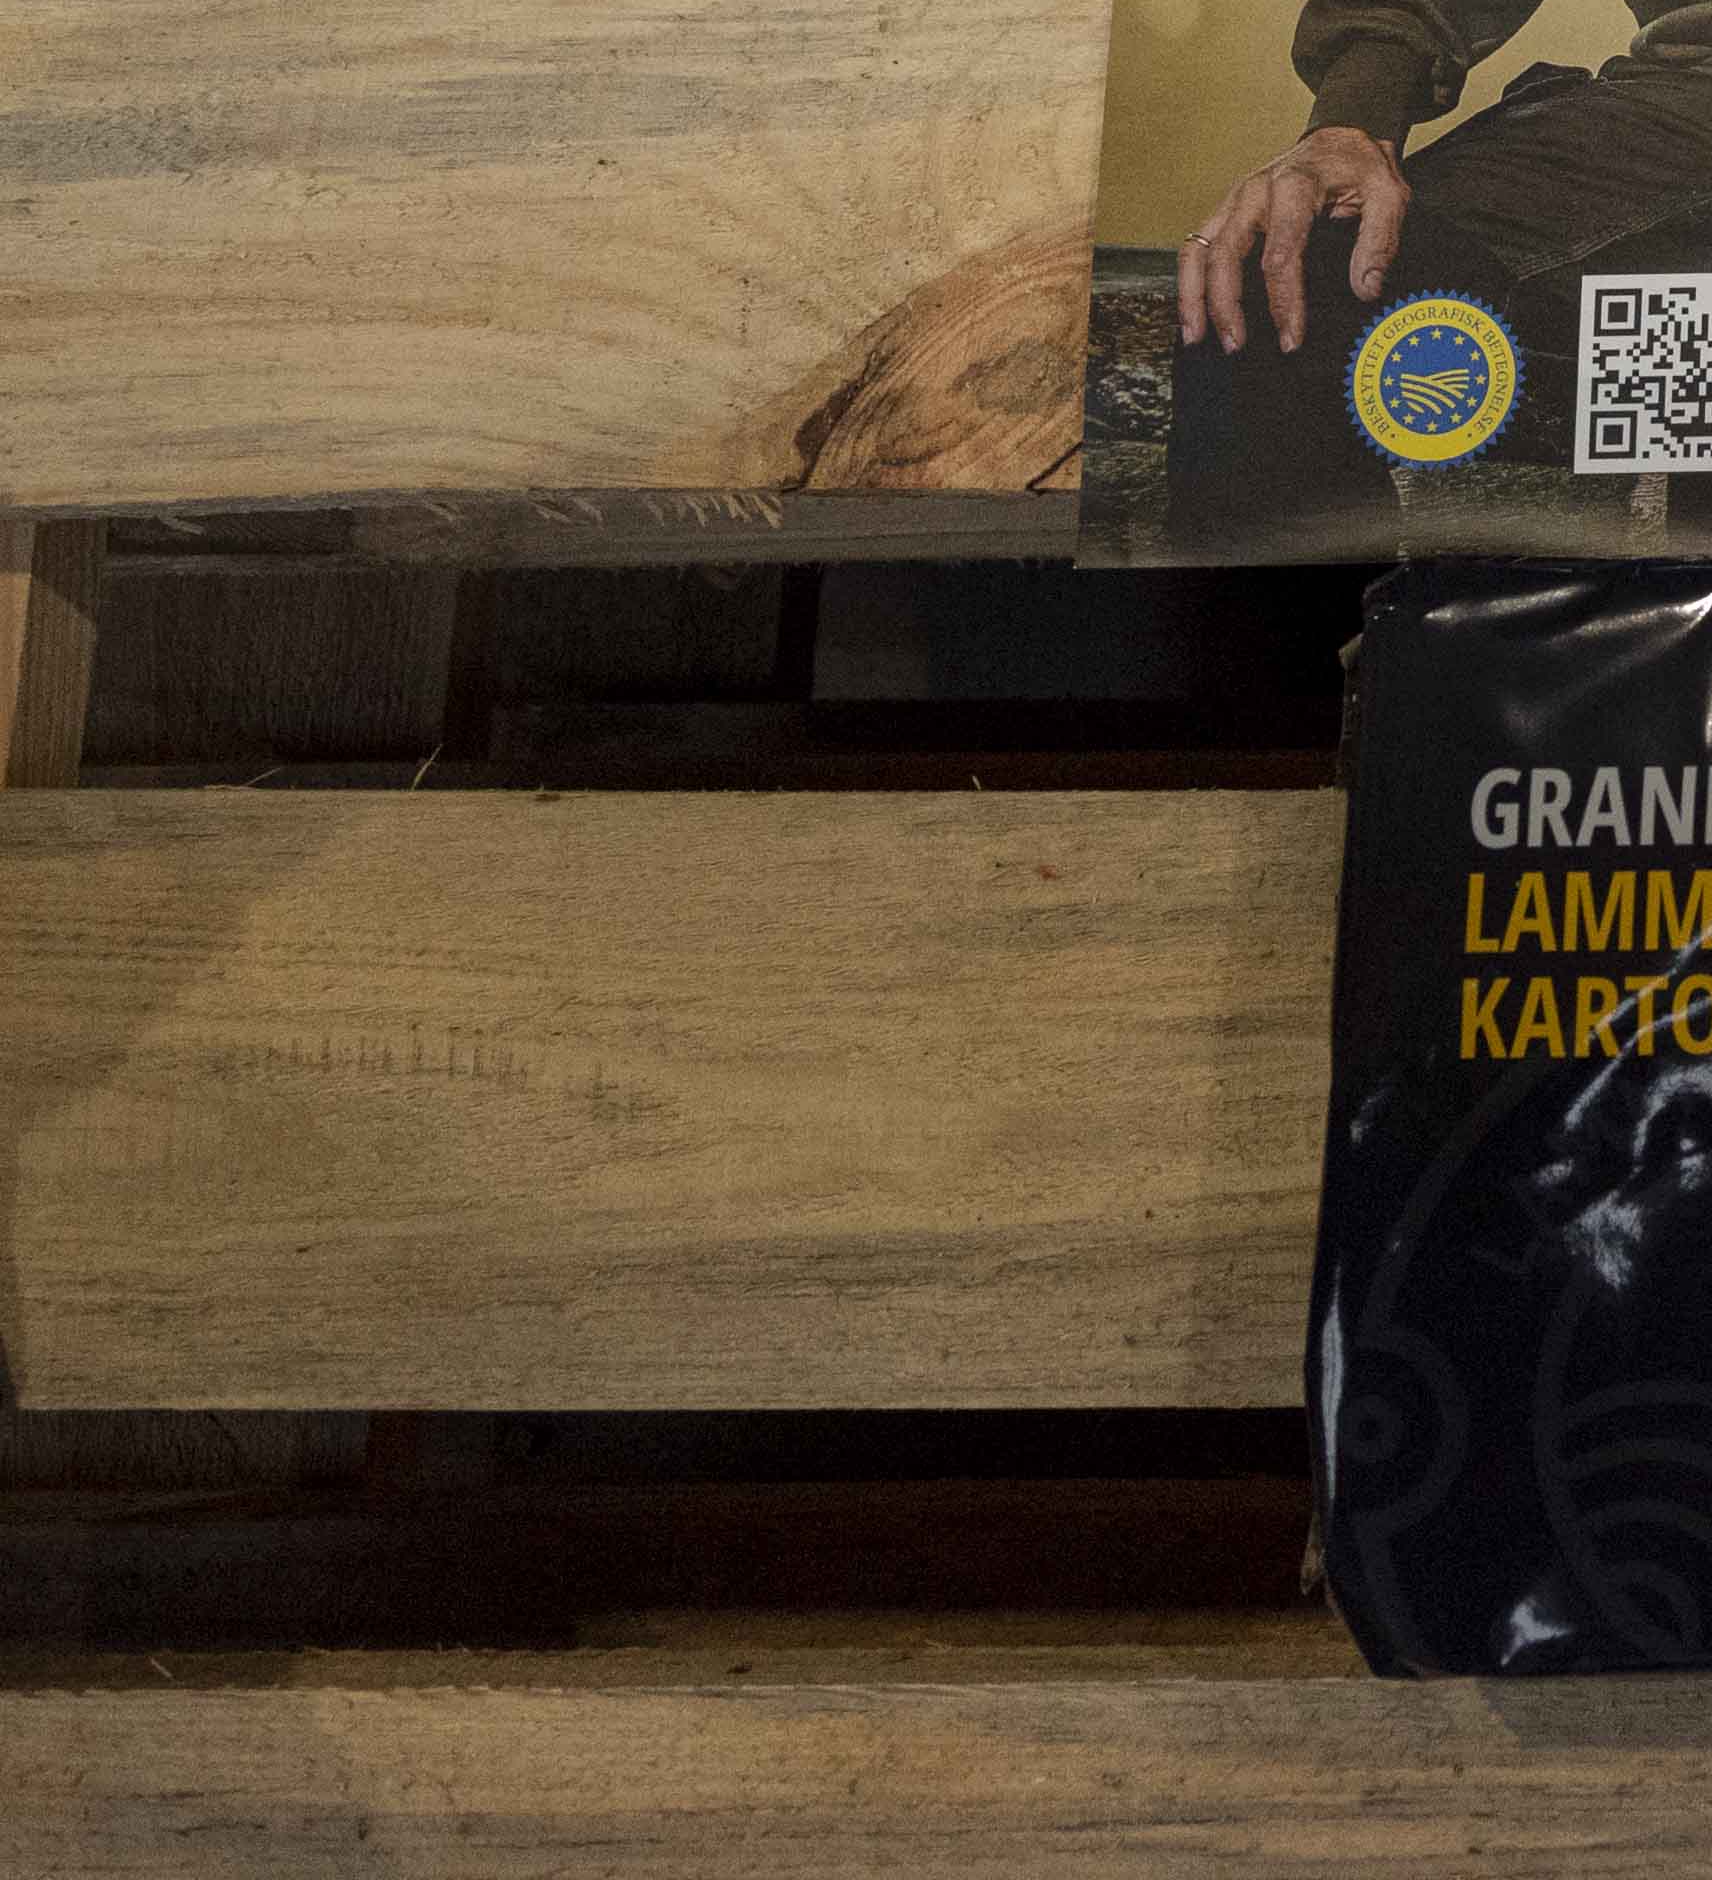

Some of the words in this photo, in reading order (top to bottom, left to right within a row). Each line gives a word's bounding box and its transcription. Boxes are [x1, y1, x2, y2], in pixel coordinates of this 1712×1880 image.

[1360, 338, 1391, 436] BESKYTTET
[1383, 306, 1482, 341] GEOGRAFISK
[1482, 329, 1509, 434] BETEGNELSE
